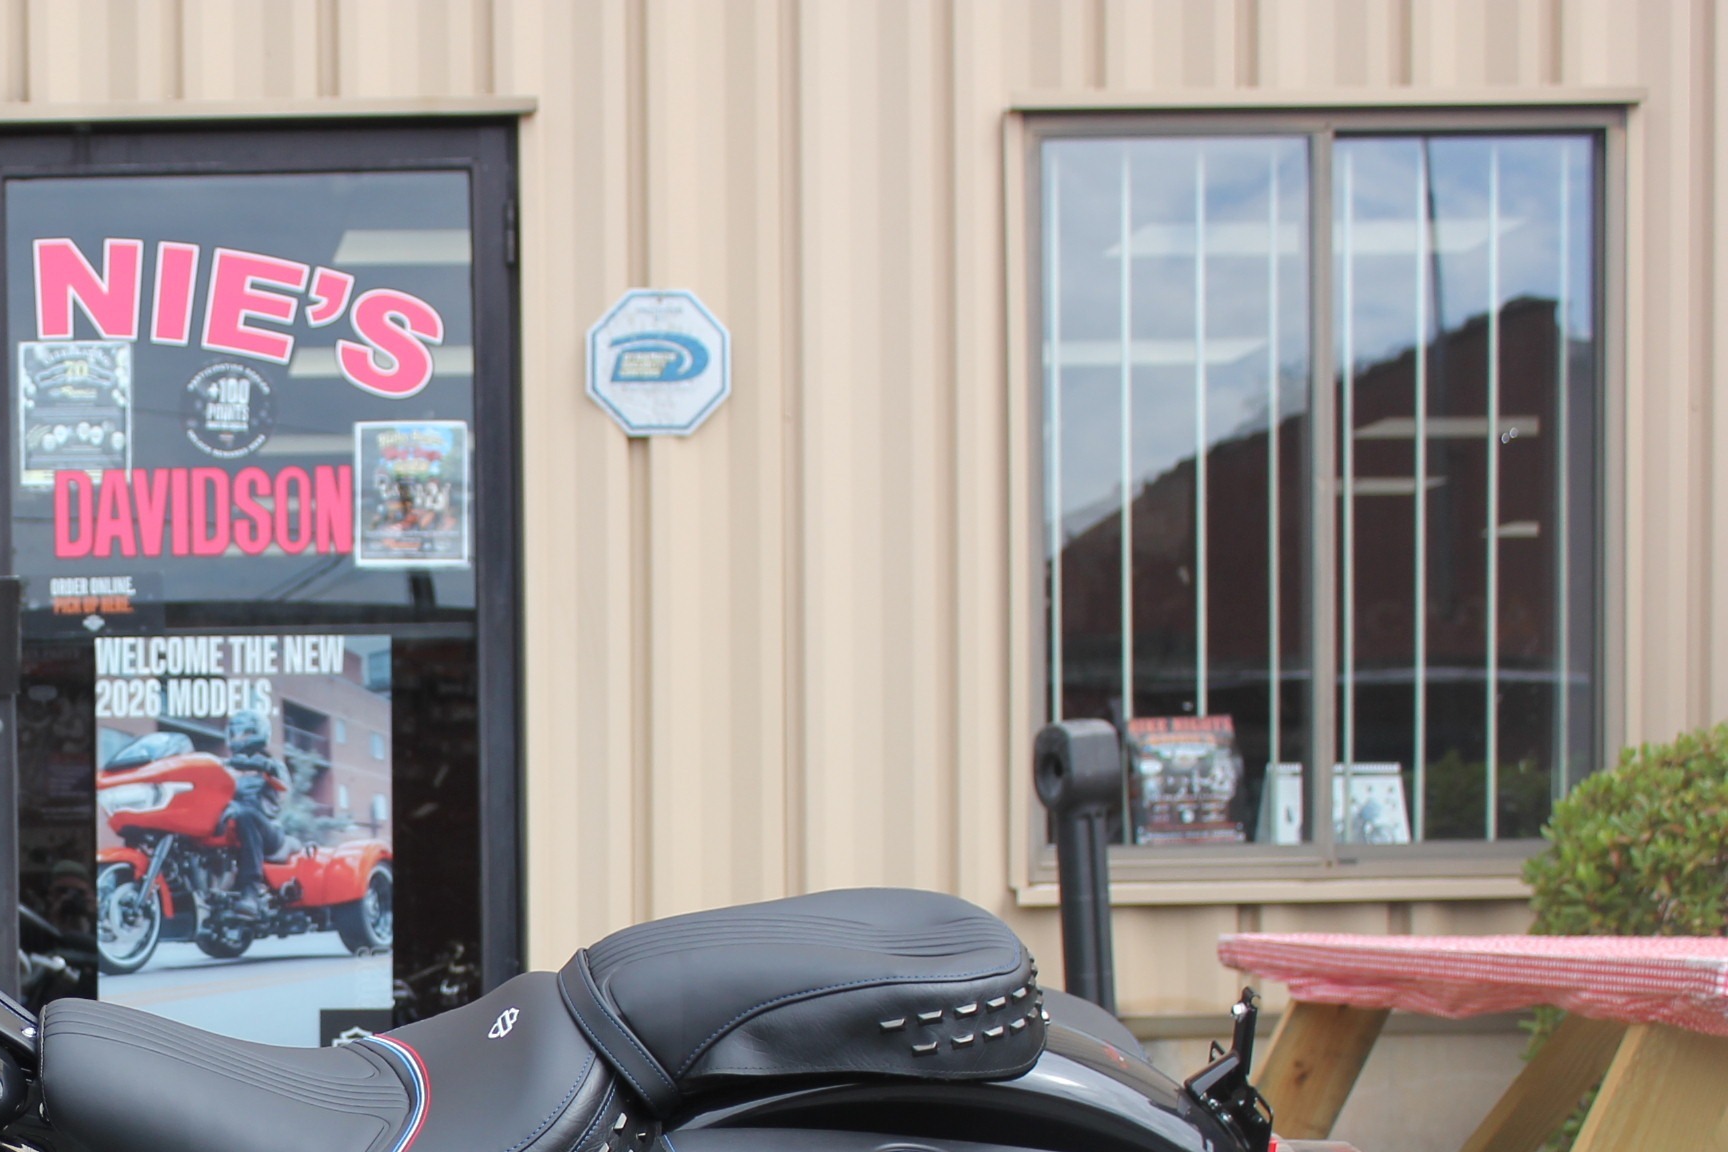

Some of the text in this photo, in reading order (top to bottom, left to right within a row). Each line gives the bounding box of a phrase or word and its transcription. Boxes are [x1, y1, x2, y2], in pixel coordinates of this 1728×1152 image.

[32, 238, 444, 399] NIE'S
[208, 378, 250, 403] +100
[53, 465, 354, 558] DAVIDSON
[50, 577, 89, 596] ORDER
[95, 635, 345, 676] WELCOME THE NEW
[95, 678, 279, 718] 2026 MODELS.
